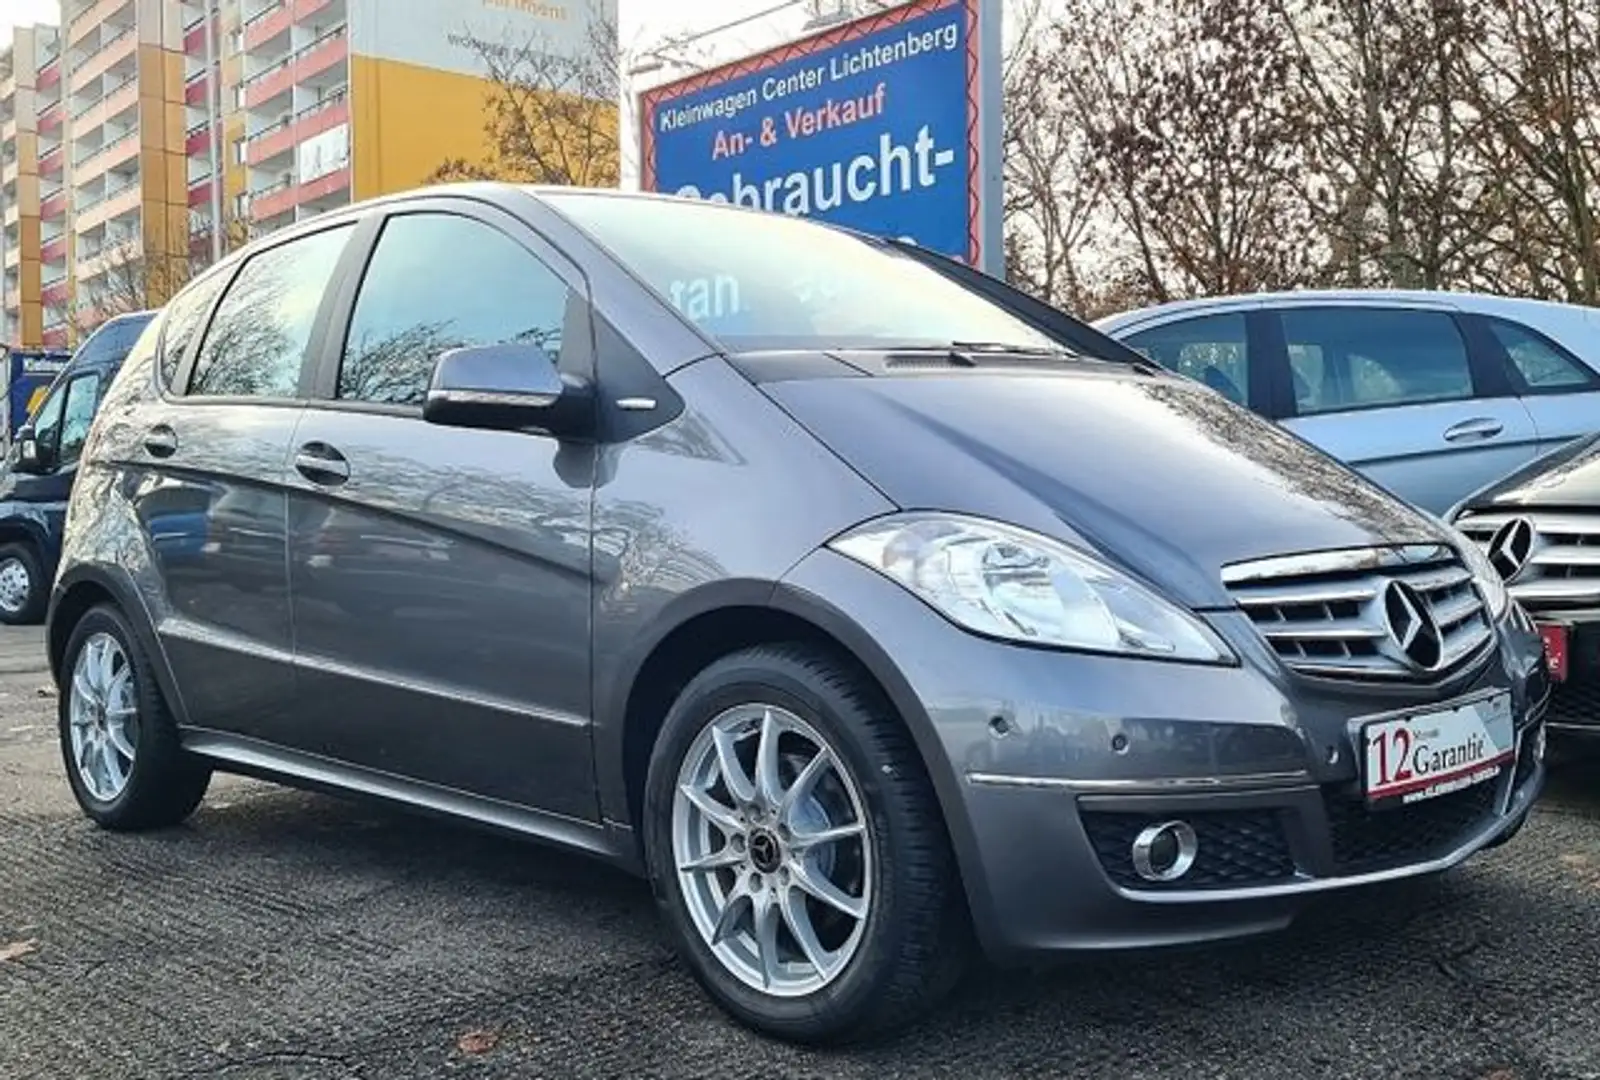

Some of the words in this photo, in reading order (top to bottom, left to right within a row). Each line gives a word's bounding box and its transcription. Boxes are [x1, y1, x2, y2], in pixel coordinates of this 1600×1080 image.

[660, 87, 757, 132] Kleinwagen
[762, 64, 825, 101] Center
[829, 22, 958, 82] Lichtenberg
[712, 129, 754, 161] An-
[759, 117, 777, 147] &
[784, 83, 887, 140] Verkauf
[1372, 727, 1413, 786] 12
[1412, 732, 1485, 775] Garantie
